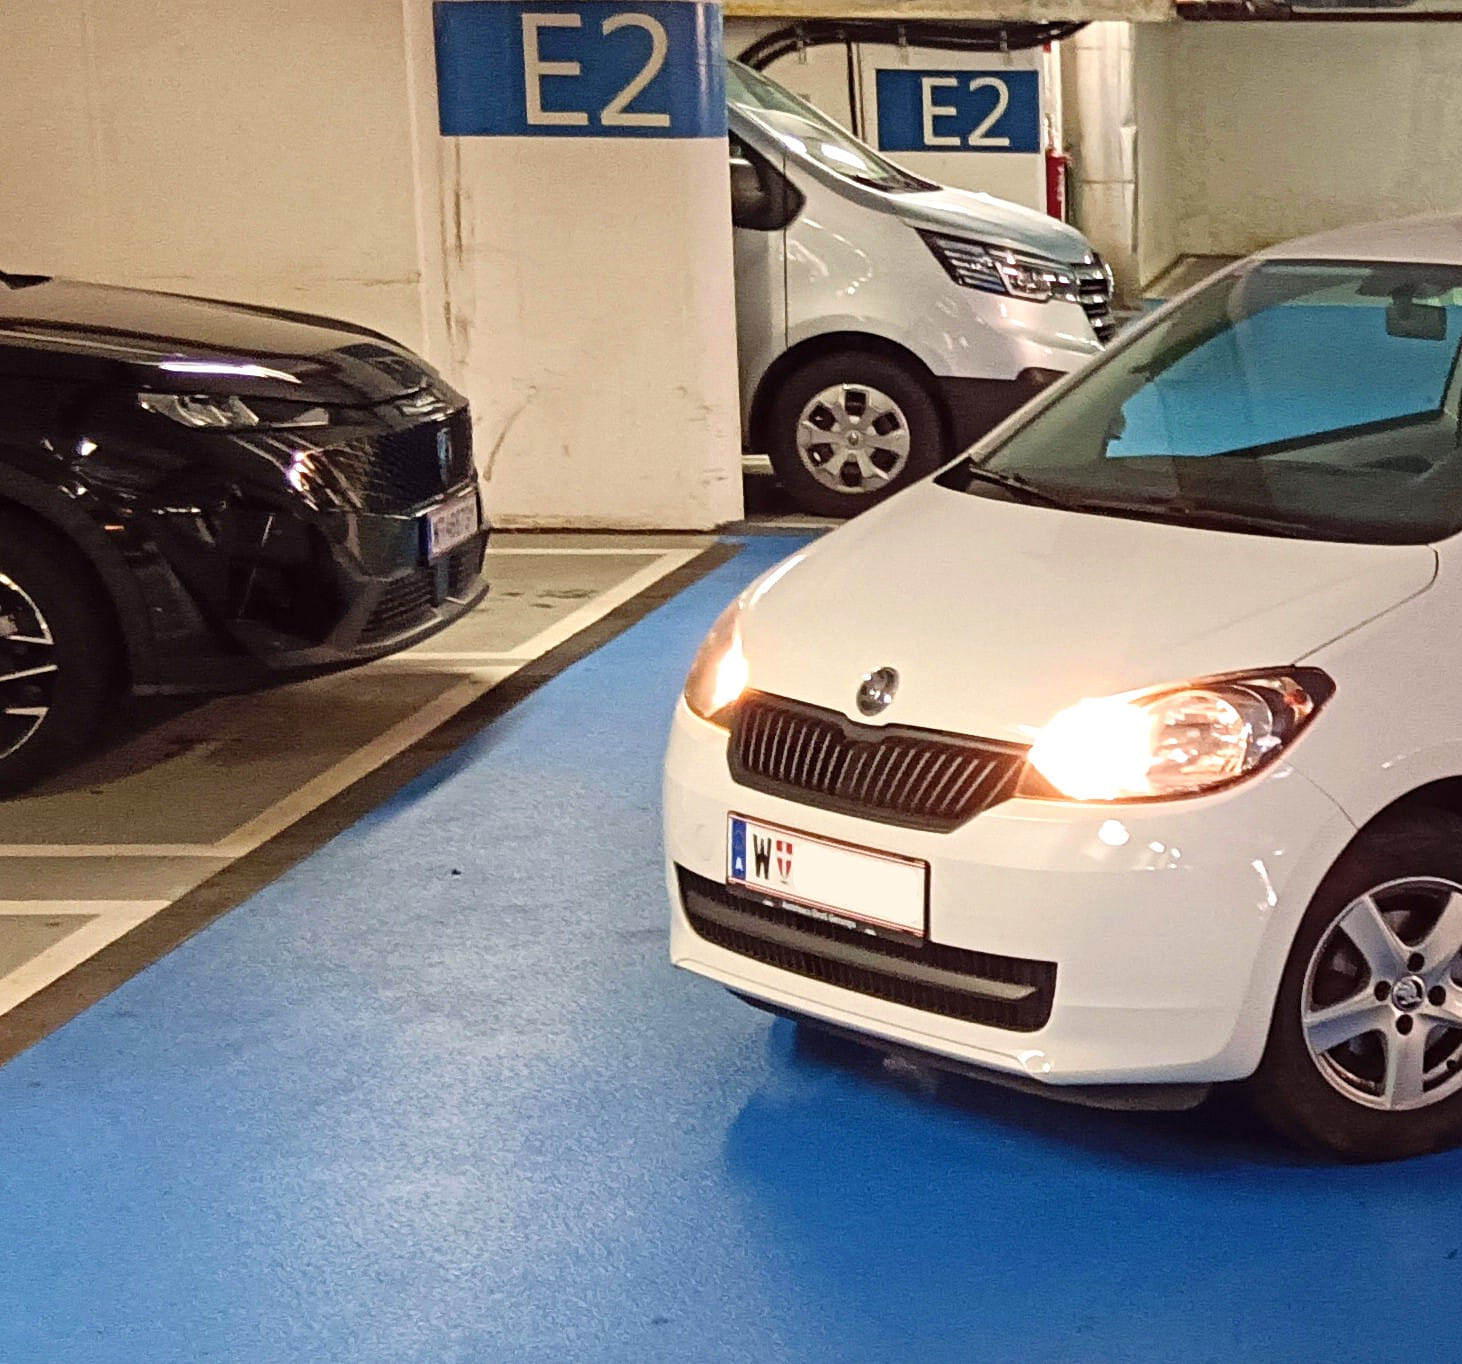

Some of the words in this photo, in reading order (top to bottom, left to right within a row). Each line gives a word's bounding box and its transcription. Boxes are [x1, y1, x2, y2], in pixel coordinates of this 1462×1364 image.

[521, 13, 671, 126] E2
[921, 77, 1011, 146] E2
[734, 856, 745, 872] A
[752, 833, 772, 881] W
